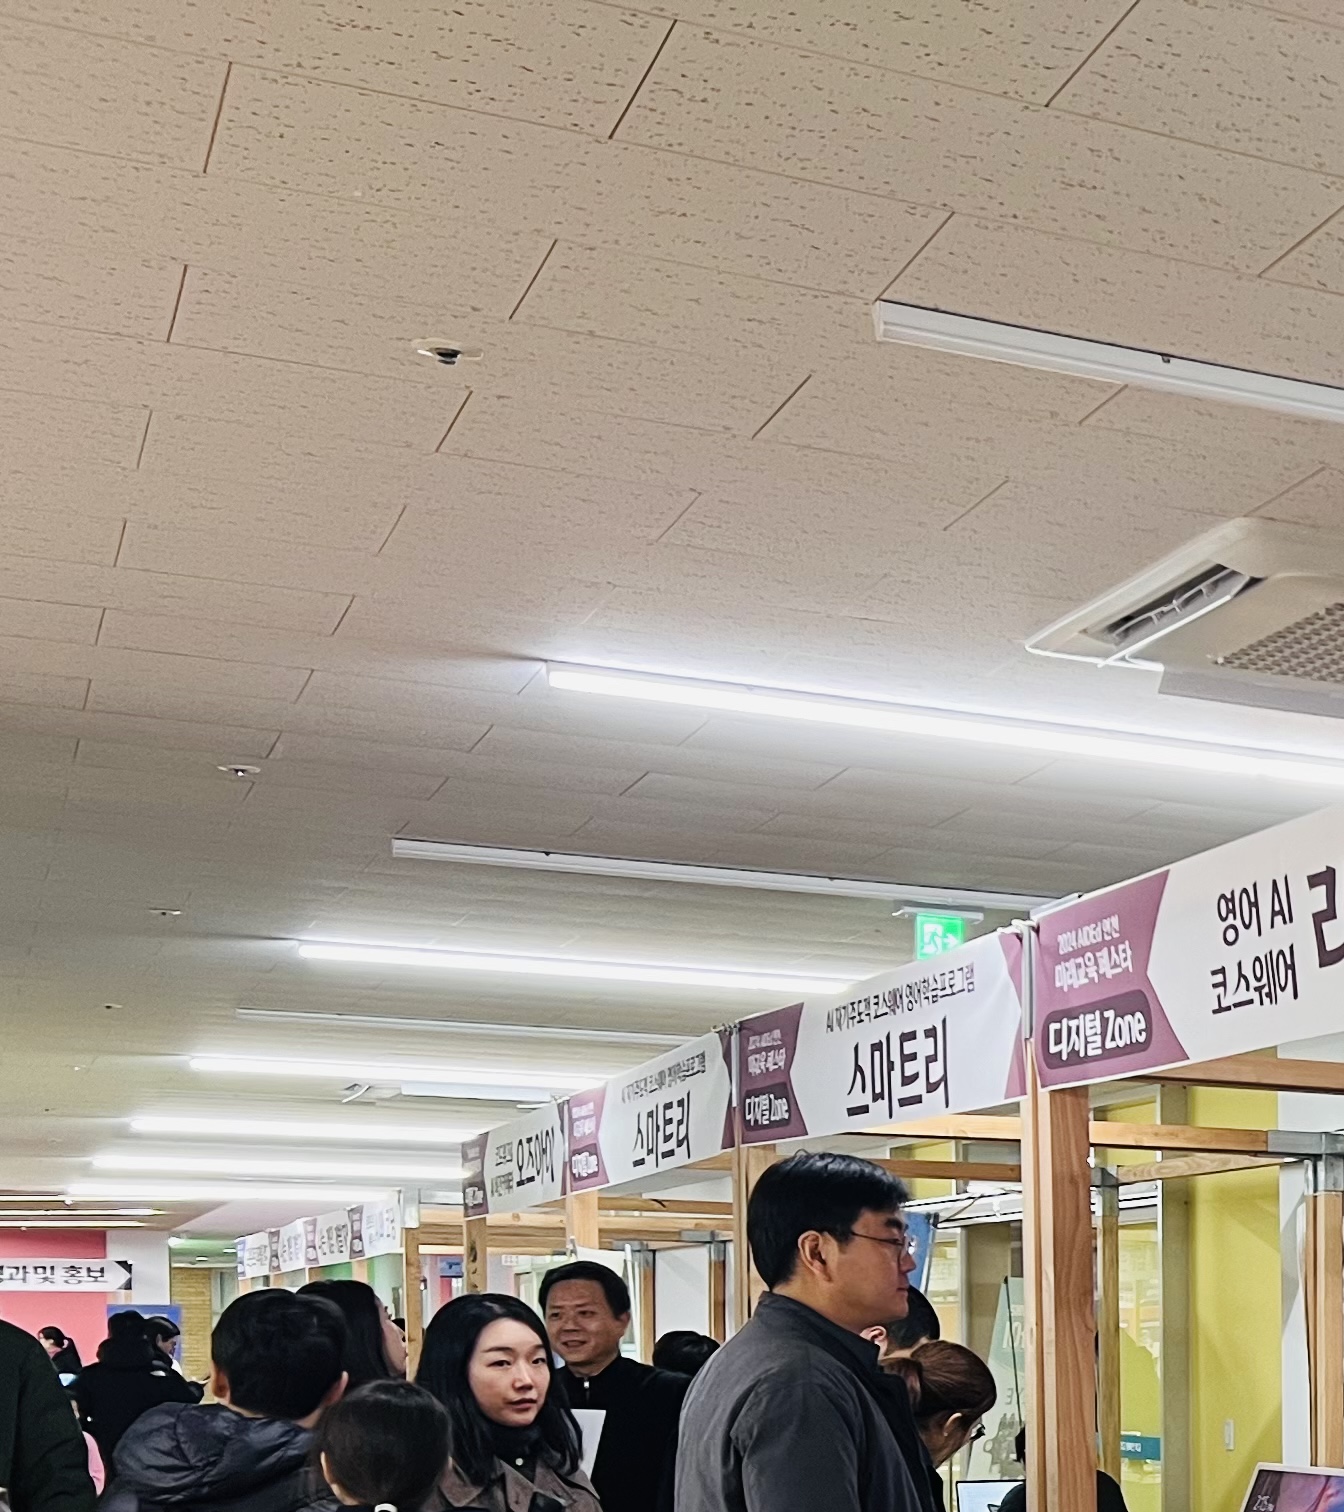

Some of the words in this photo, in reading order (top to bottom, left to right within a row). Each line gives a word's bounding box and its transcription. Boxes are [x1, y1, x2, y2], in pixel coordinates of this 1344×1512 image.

[1216, 879, 1261, 947] 영어
[1270, 873, 1293, 927] AI
[1055, 951, 1099, 992] 미래교육
[1097, 940, 1133, 979] 페스타
[1210, 943, 1298, 1015] 코스웨어
[847, 1014, 949, 1119] 스마트리
[1049, 1010, 1102, 1061] 디지털
[1104, 1009, 1146, 1049] Zone
[632, 1090, 691, 1168] 스마트리
[745, 1094, 769, 1127] 디지털
[769, 1094, 789, 1121] Zone
